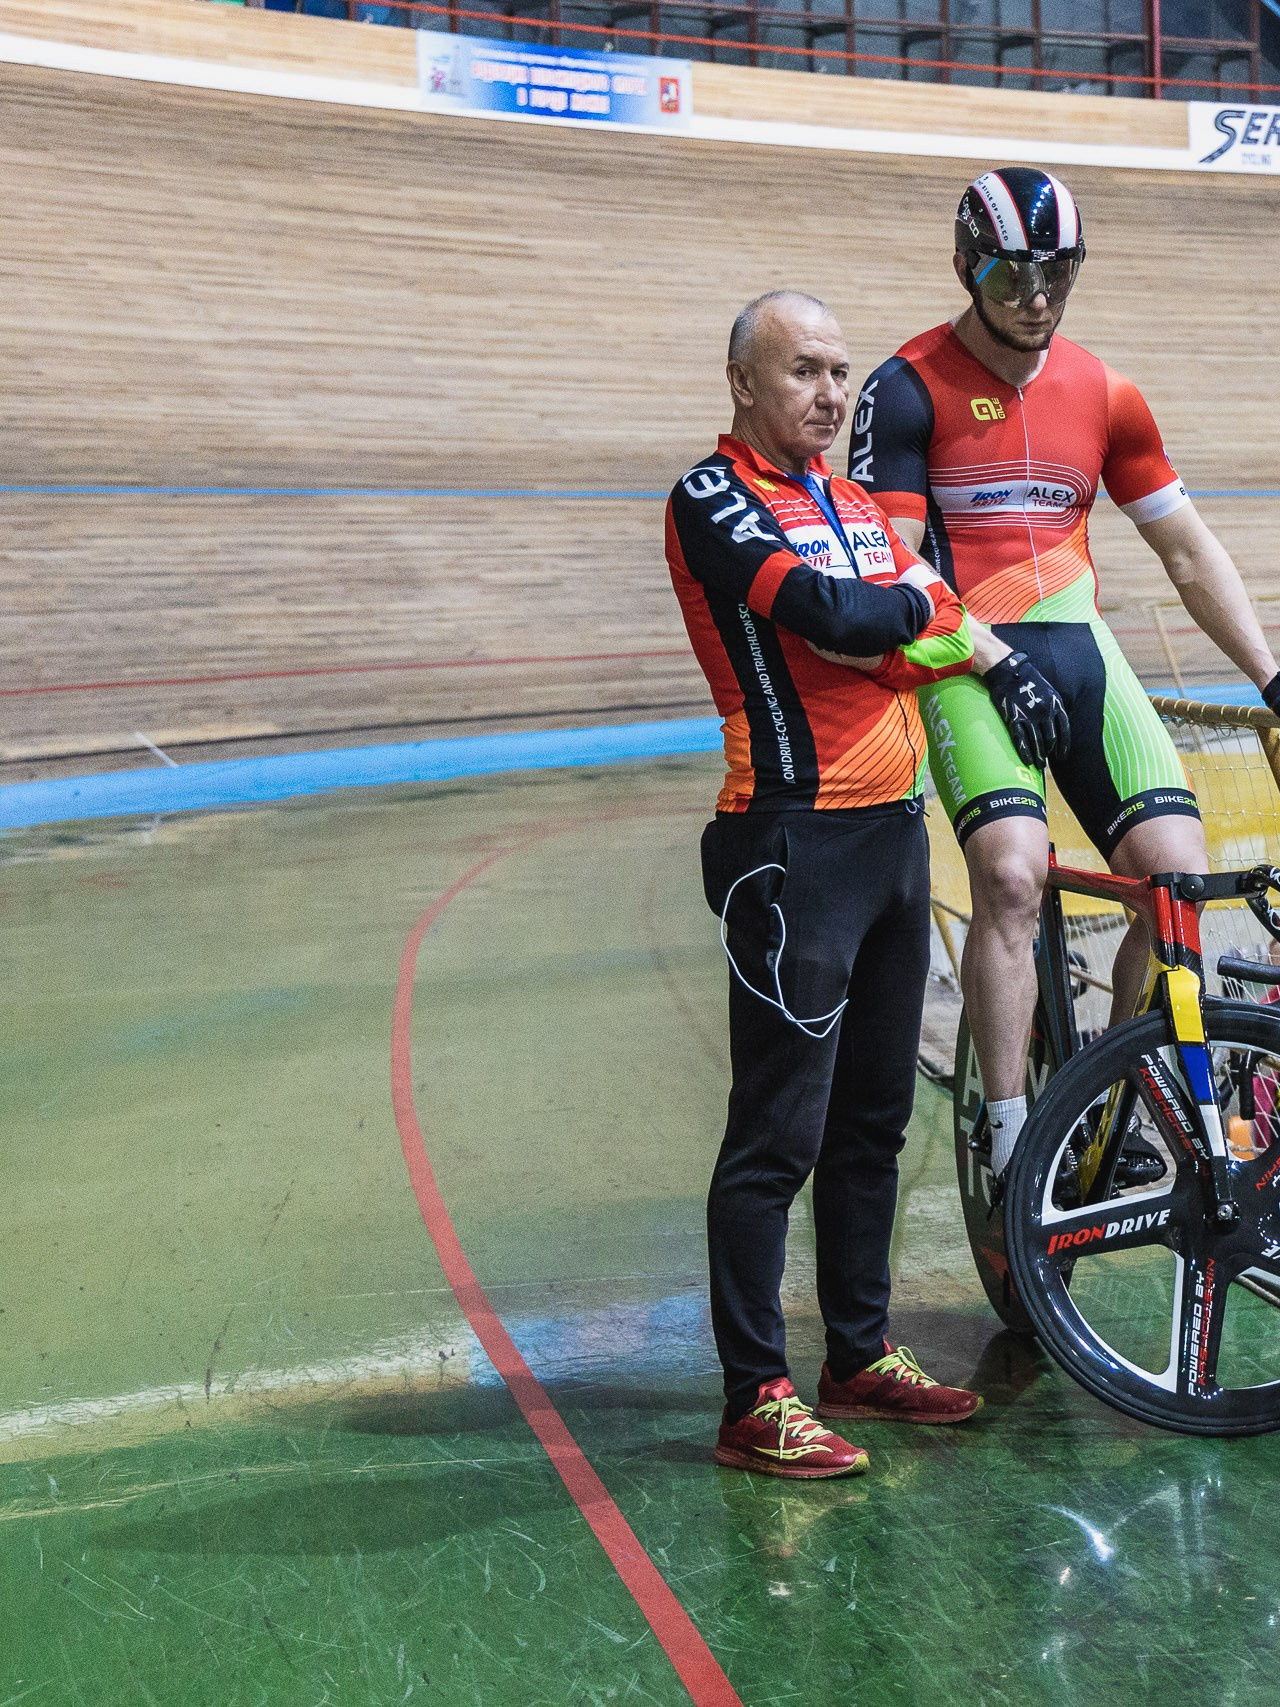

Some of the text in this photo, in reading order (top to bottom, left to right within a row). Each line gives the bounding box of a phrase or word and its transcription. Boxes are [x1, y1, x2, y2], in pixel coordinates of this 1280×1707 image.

[850, 379, 879, 483] ALEX
[682, 466, 782, 544] ALE
[1026, 486, 1076, 504] ALEX
[1032, 498, 1063, 508] TEAM
[745, 616, 769, 673] TRIATHLON
[759, 673, 776, 697] AND
[990, 796, 1038, 809] BIKE215
[1106, 800, 1146, 836] BIKE215
[1140, 1053, 1194, 1133] POWERED
[1046, 1208, 1171, 1256] IRONDRIVE
[1188, 1270, 1205, 1396] POWERED BY
